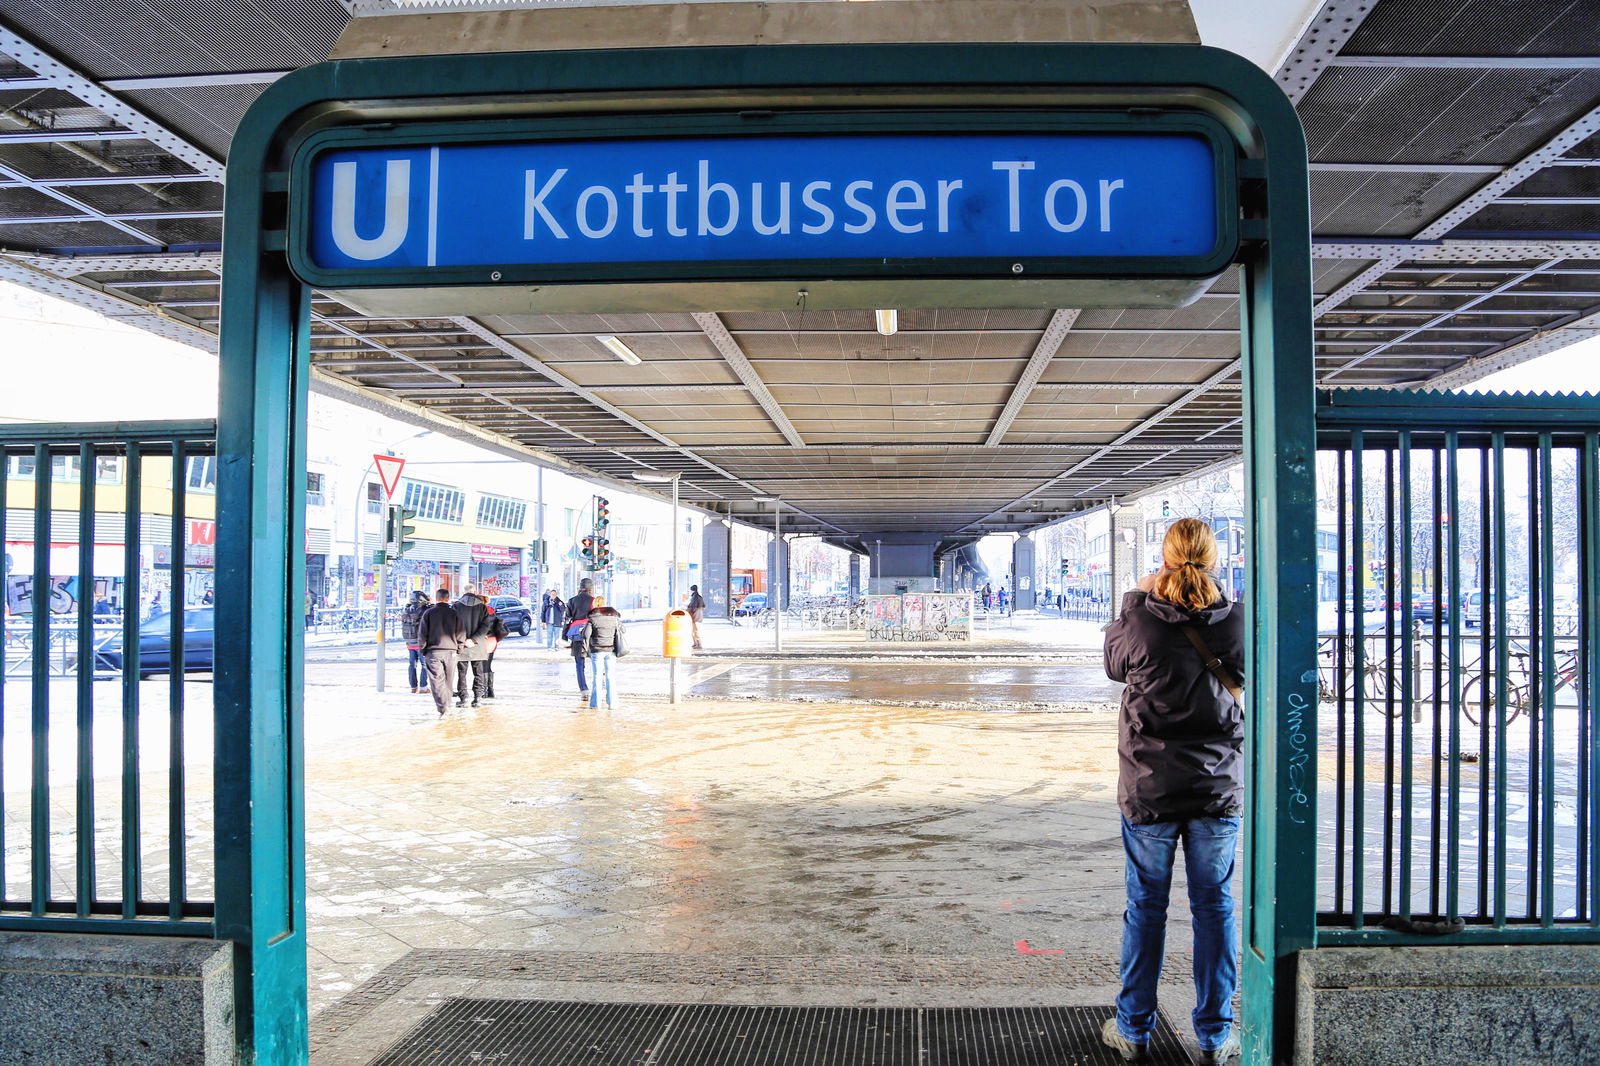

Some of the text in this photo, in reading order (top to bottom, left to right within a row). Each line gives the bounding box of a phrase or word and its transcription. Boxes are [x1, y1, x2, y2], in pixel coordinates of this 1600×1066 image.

[331, 159, 1124, 261] U Kottbusser Tor
